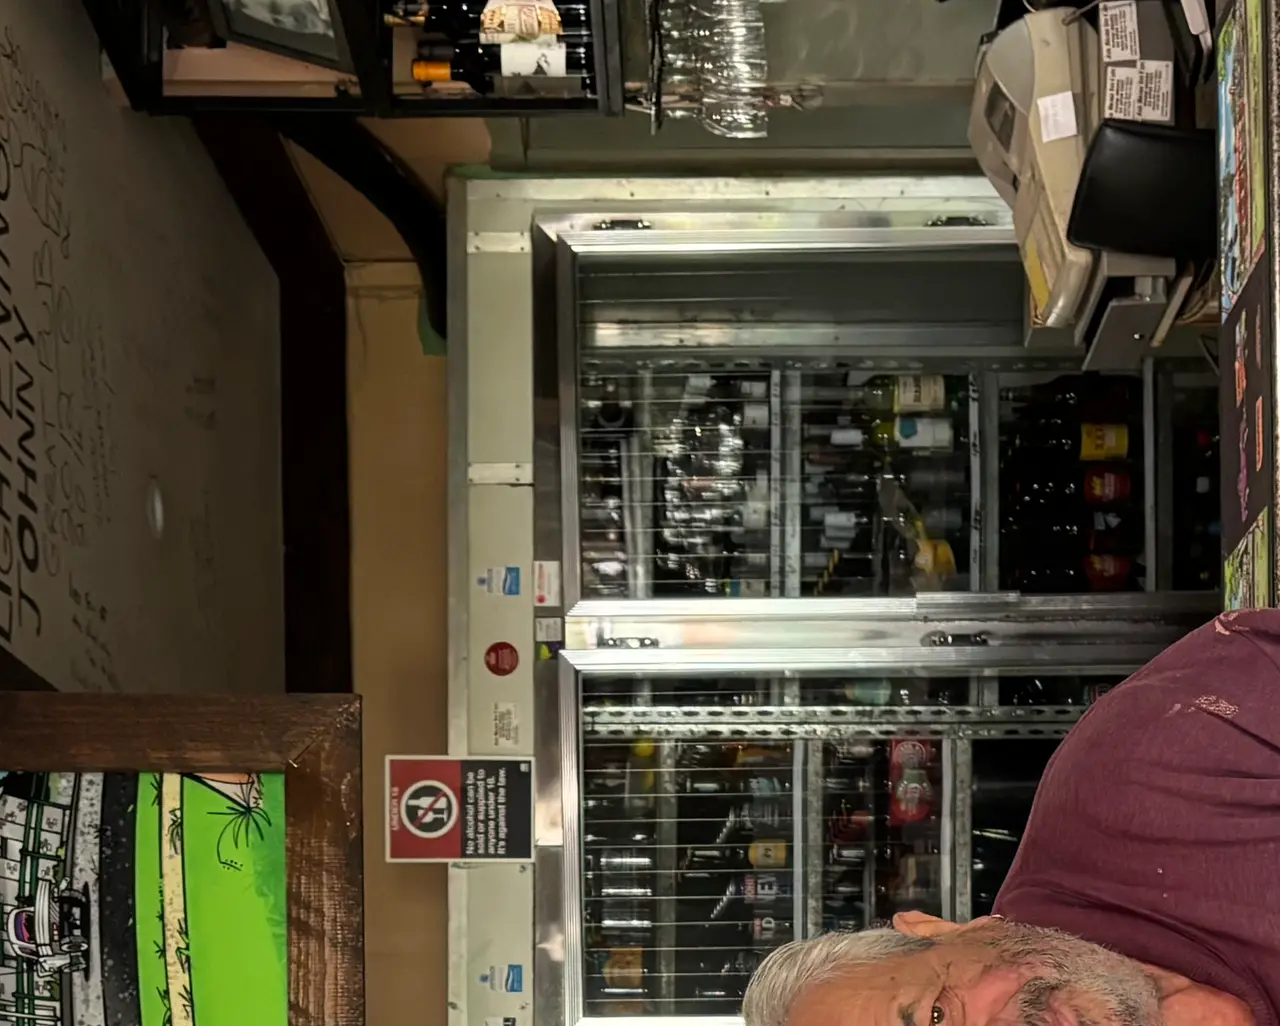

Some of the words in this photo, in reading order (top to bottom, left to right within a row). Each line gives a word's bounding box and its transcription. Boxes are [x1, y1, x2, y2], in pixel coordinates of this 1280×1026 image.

[12, 302, 42, 636] JOHNNY
[465, 771, 475, 784] be
[477, 768, 486, 779] to
[466, 785, 475, 803] can
[476, 780, 488, 821] supplied
[486, 791, 496, 819] under
[496, 787, 507, 803] the
[465, 804, 475, 839] alcohol
[497, 804, 509, 840] against
[465, 841, 475, 854] No
[476, 834, 486, 854] sold
[487, 820, 498, 854] anyone
